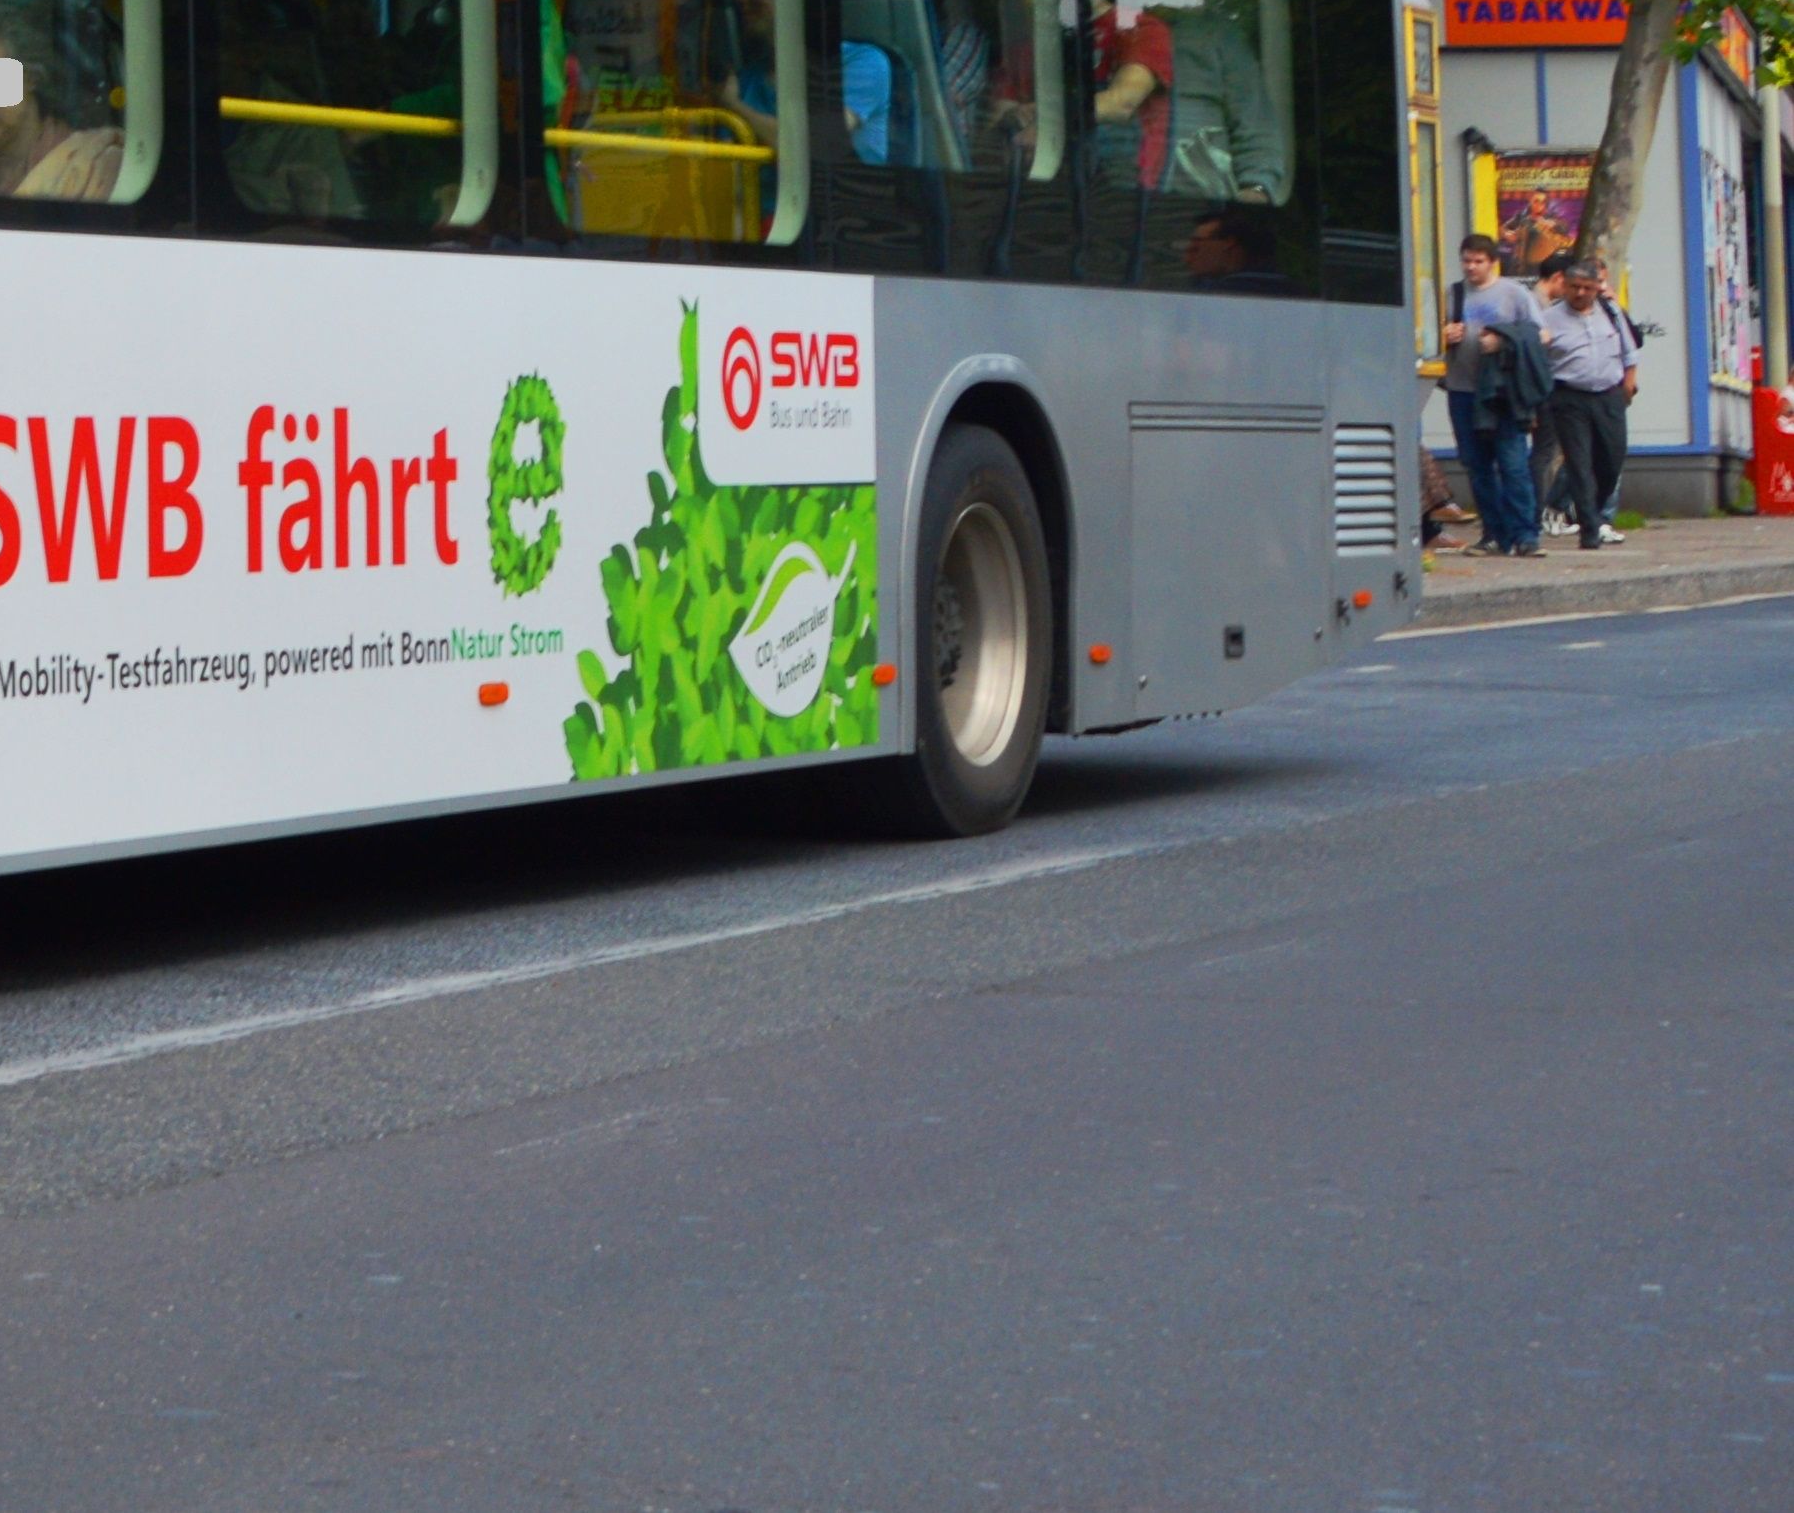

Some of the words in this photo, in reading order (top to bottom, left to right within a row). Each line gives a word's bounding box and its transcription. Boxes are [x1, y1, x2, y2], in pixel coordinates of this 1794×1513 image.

[771, 332, 860, 387] SWB
[771, 400, 793, 429] Bus
[796, 400, 819, 429] und
[822, 400, 852, 429] Bahn
[238, 404, 459, 574] fährt
[487, 370, 567, 599] e
[264, 634, 354, 688] powered
[361, 630, 394, 670] mit
[509, 622, 564, 658] Strom
